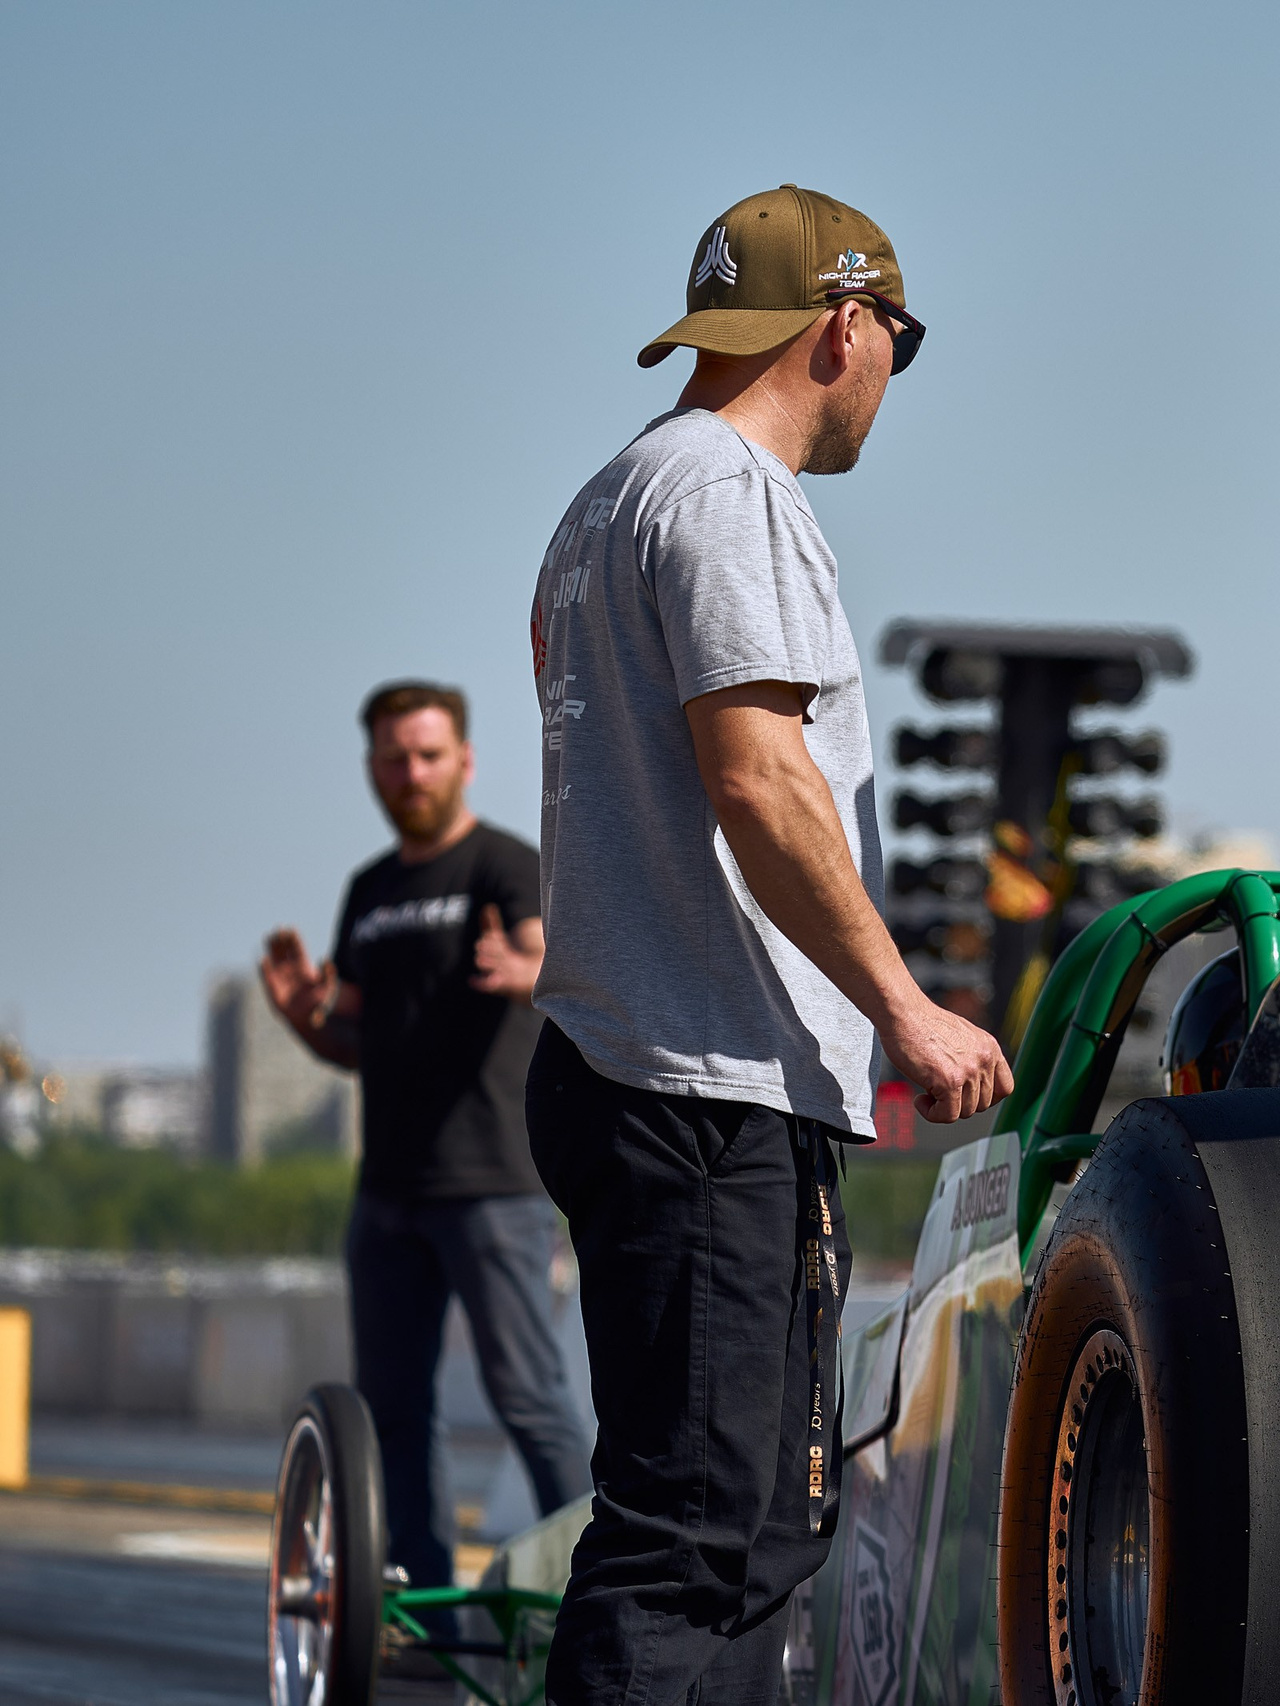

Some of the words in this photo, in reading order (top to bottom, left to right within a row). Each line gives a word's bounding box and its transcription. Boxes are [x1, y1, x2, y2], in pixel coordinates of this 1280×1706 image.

[818, 272, 850, 280] NIGHT
[851, 269, 881, 280] RACER
[839, 280, 866, 288] TEAM
[812, 1382, 821, 1415] years
[809, 1445, 823, 1498] RDRC
